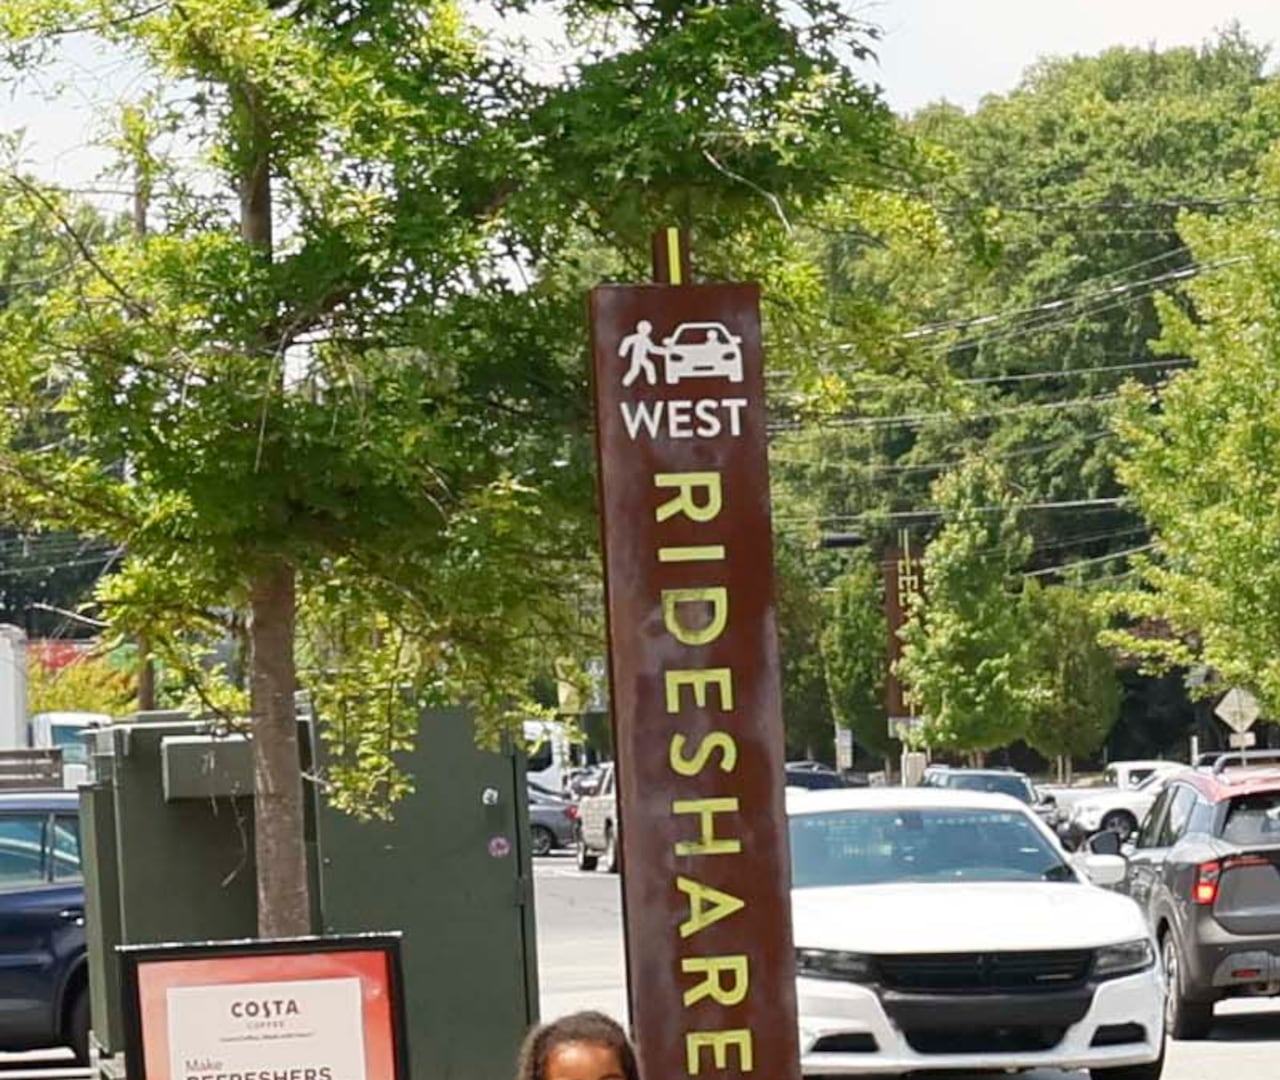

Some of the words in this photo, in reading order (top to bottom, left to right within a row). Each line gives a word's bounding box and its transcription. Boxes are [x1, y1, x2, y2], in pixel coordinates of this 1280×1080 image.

[620, 398, 748, 440] WEST
[654, 472, 753, 1076] RIDESHARE
[230, 999, 299, 1018] COSTA
[185, 1058, 223, 1072] Make
